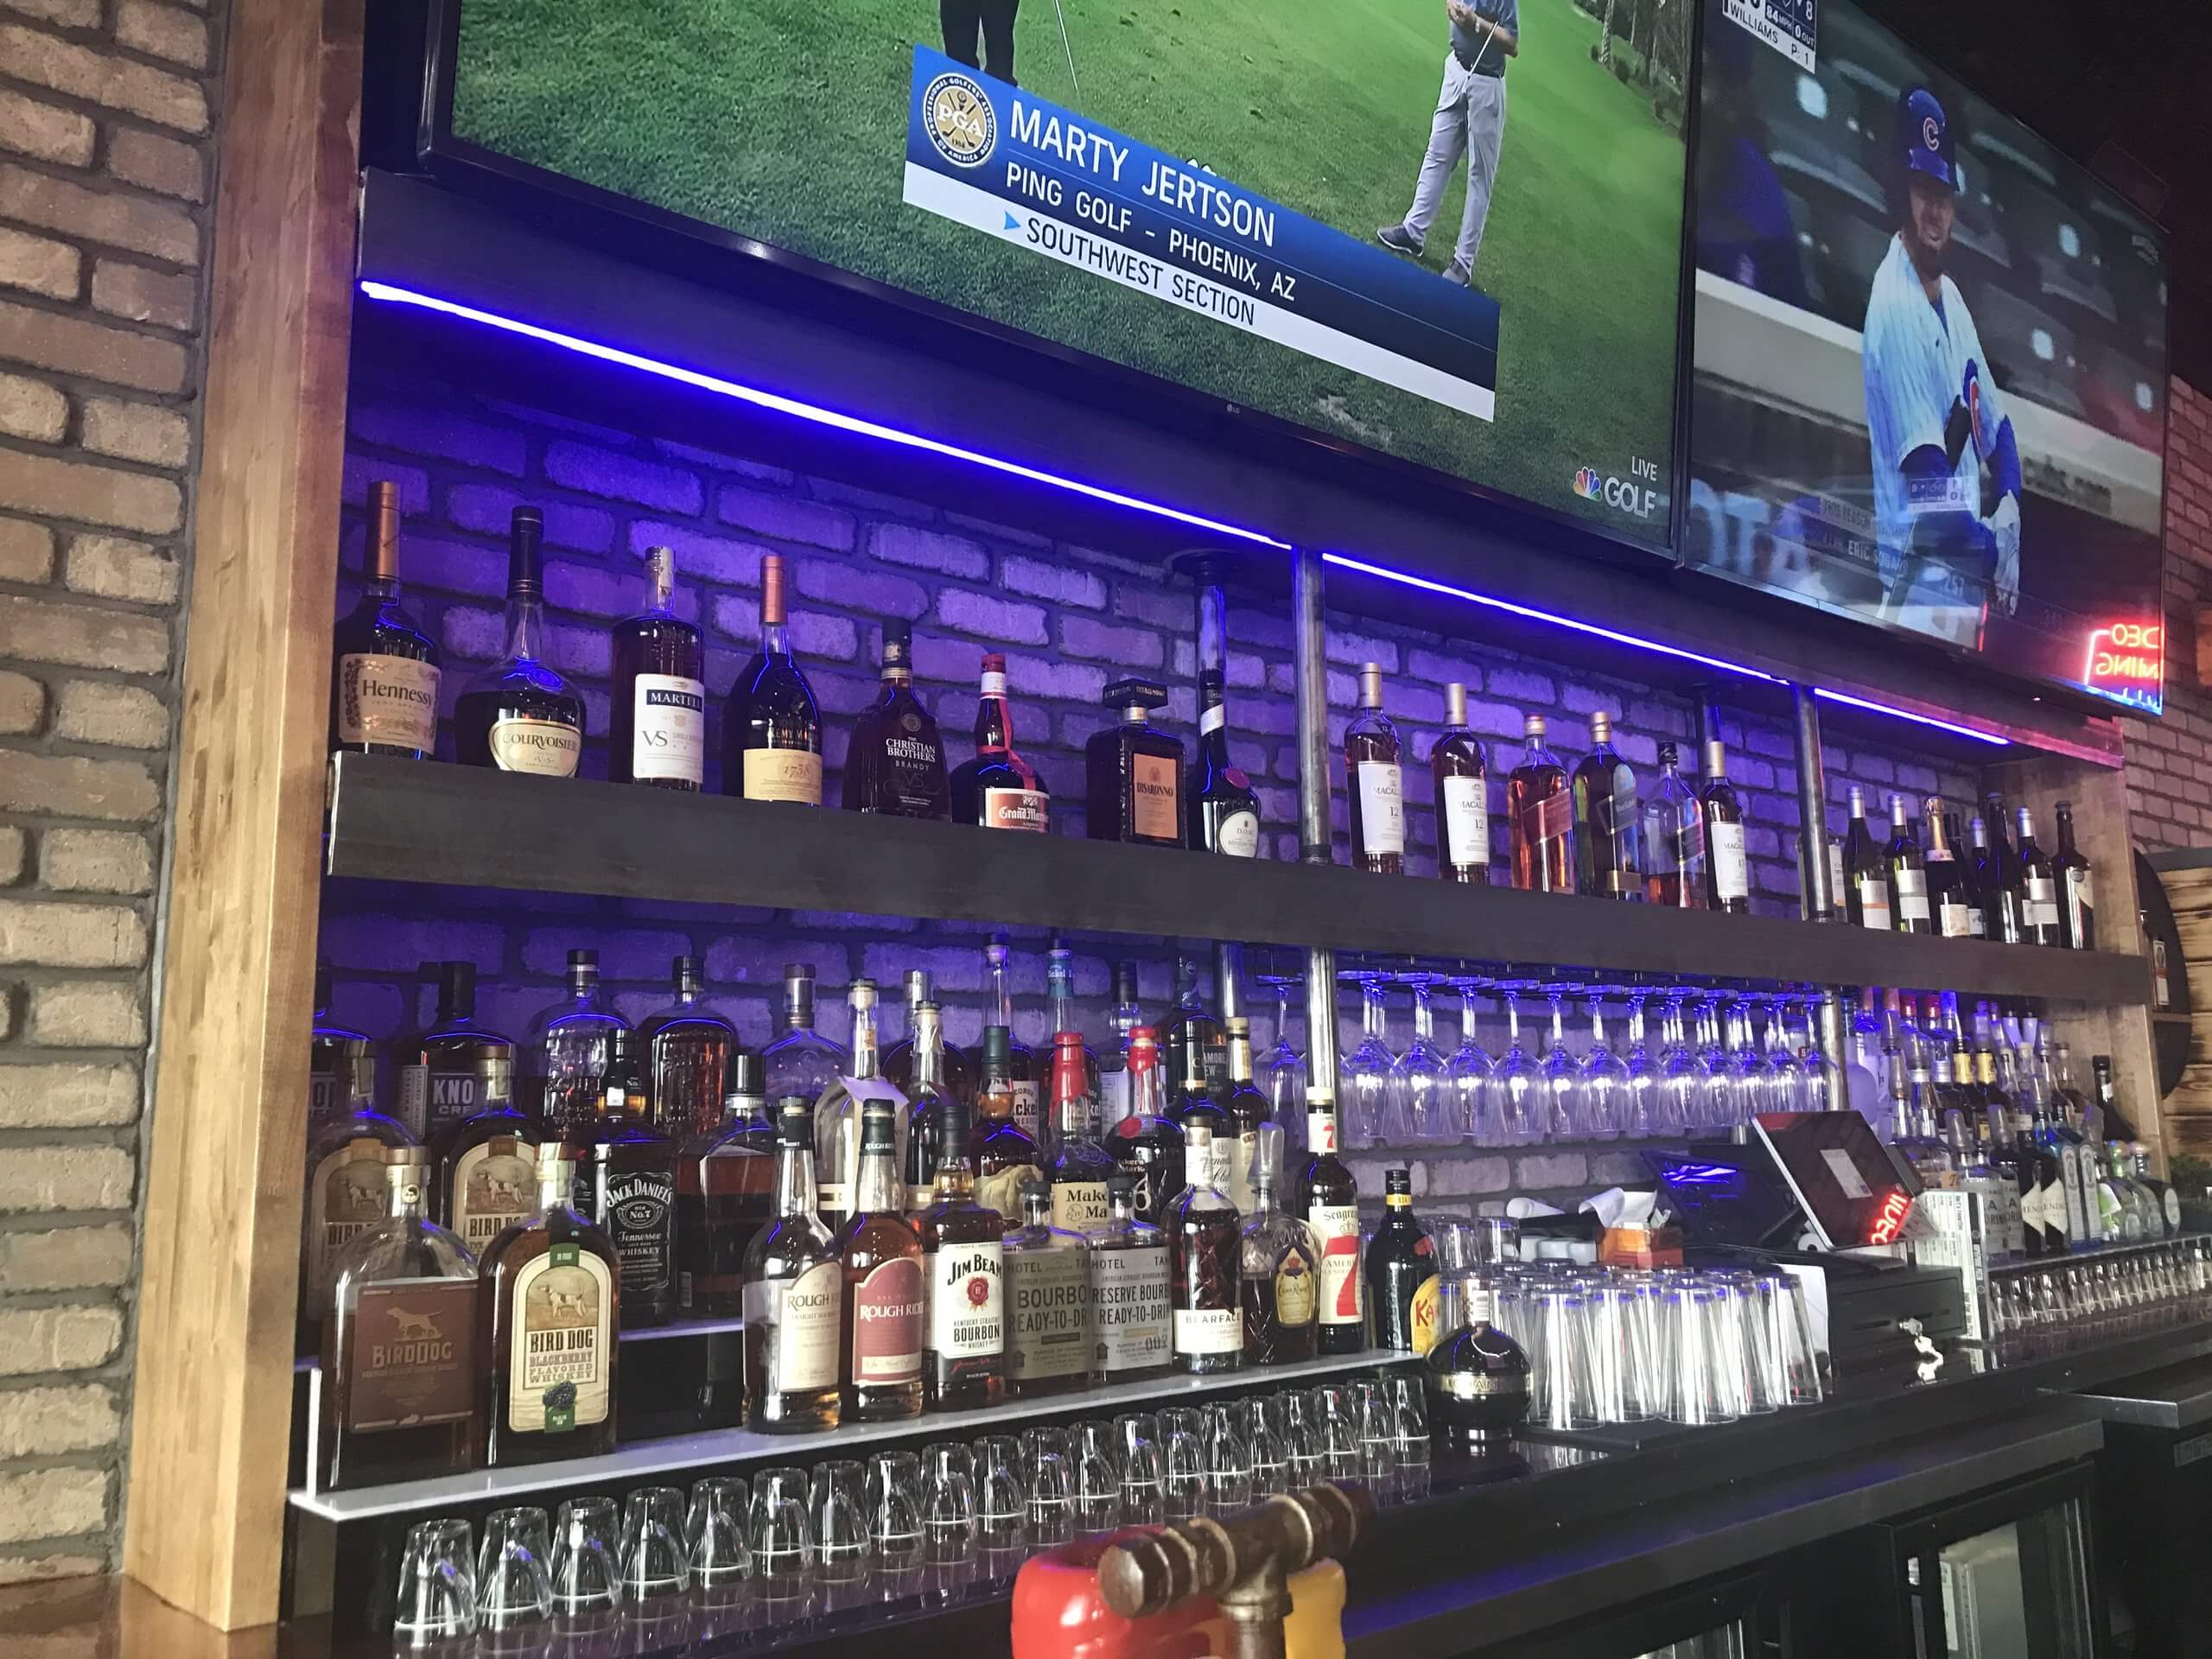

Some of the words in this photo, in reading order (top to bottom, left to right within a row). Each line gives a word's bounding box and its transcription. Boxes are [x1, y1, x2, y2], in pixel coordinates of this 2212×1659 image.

[1766, 5, 1778, 23] 84
[1806, 1, 1813, 21] 8
[1730, 2, 1778, 44] WILLIAMS
[1804, 52, 1808, 65] 1
[1795, 25, 1802, 38] 0
[1802, 33, 1815, 47] OUT
[937, 102, 984, 138] PGA
[1010, 99, 1128, 181] MARTY
[1141, 162, 1274, 247] JERTSON
[1006, 162, 1063, 207] PING
[1075, 192, 1132, 233] GOLF
[1168, 229, 1262, 290] PHOENIX,
[1270, 272, 1296, 302] AZ
[1027, 218, 1164, 290] SOUTHWEST
[1171, 274, 1255, 326] SECTION
[1631, 455, 1657, 481] LIVE
[1604, 476, 1656, 518] GOLF
[642, 730, 668, 747] VS
[886, 738, 936, 754] CHRISTIAN
[887, 747, 936, 763] BROTHERS
[895, 760, 930, 772] BRANDY
[1136, 782, 1173, 797] DISARONNO
[1389, 806, 1399, 817] 12
[1474, 819, 1484, 830] 12
[1324, 1125, 1334, 1148] 7
[606, 1183, 634, 1207] JACK
[634, 1178, 672, 1205] DANIEL'S
[629, 1210, 652, 1219] No.7
[469, 1217, 500, 1237] BIRD
[618, 1231, 662, 1243] Tennessee
[619, 1247, 660, 1256] WHISKEY
[947, 1258, 971, 1286] JIM
[974, 1253, 1002, 1280] BEAM
[1008, 1262, 1043, 1274] HOTEL
[1091, 1258, 1126, 1270] HOTEL
[1322, 1235, 1360, 1317] 7
[787, 1294, 830, 1312] ROUGH
[1091, 1285, 1137, 1305] RESERVE
[860, 1305, 904, 1322] ROUGH
[953, 1318, 978, 1327] KENTUCKY
[530, 1332, 563, 1353] BIRD
[567, 1328, 594, 1351] DOG
[953, 1325, 1000, 1343] BOURBON
[968, 1340, 988, 1350] WHISKEY
[529, 1351, 594, 1369] BLACKBERRY
[529, 1363, 593, 1376] FLAVORED
[529, 1372, 592, 1384] WHISKEY
